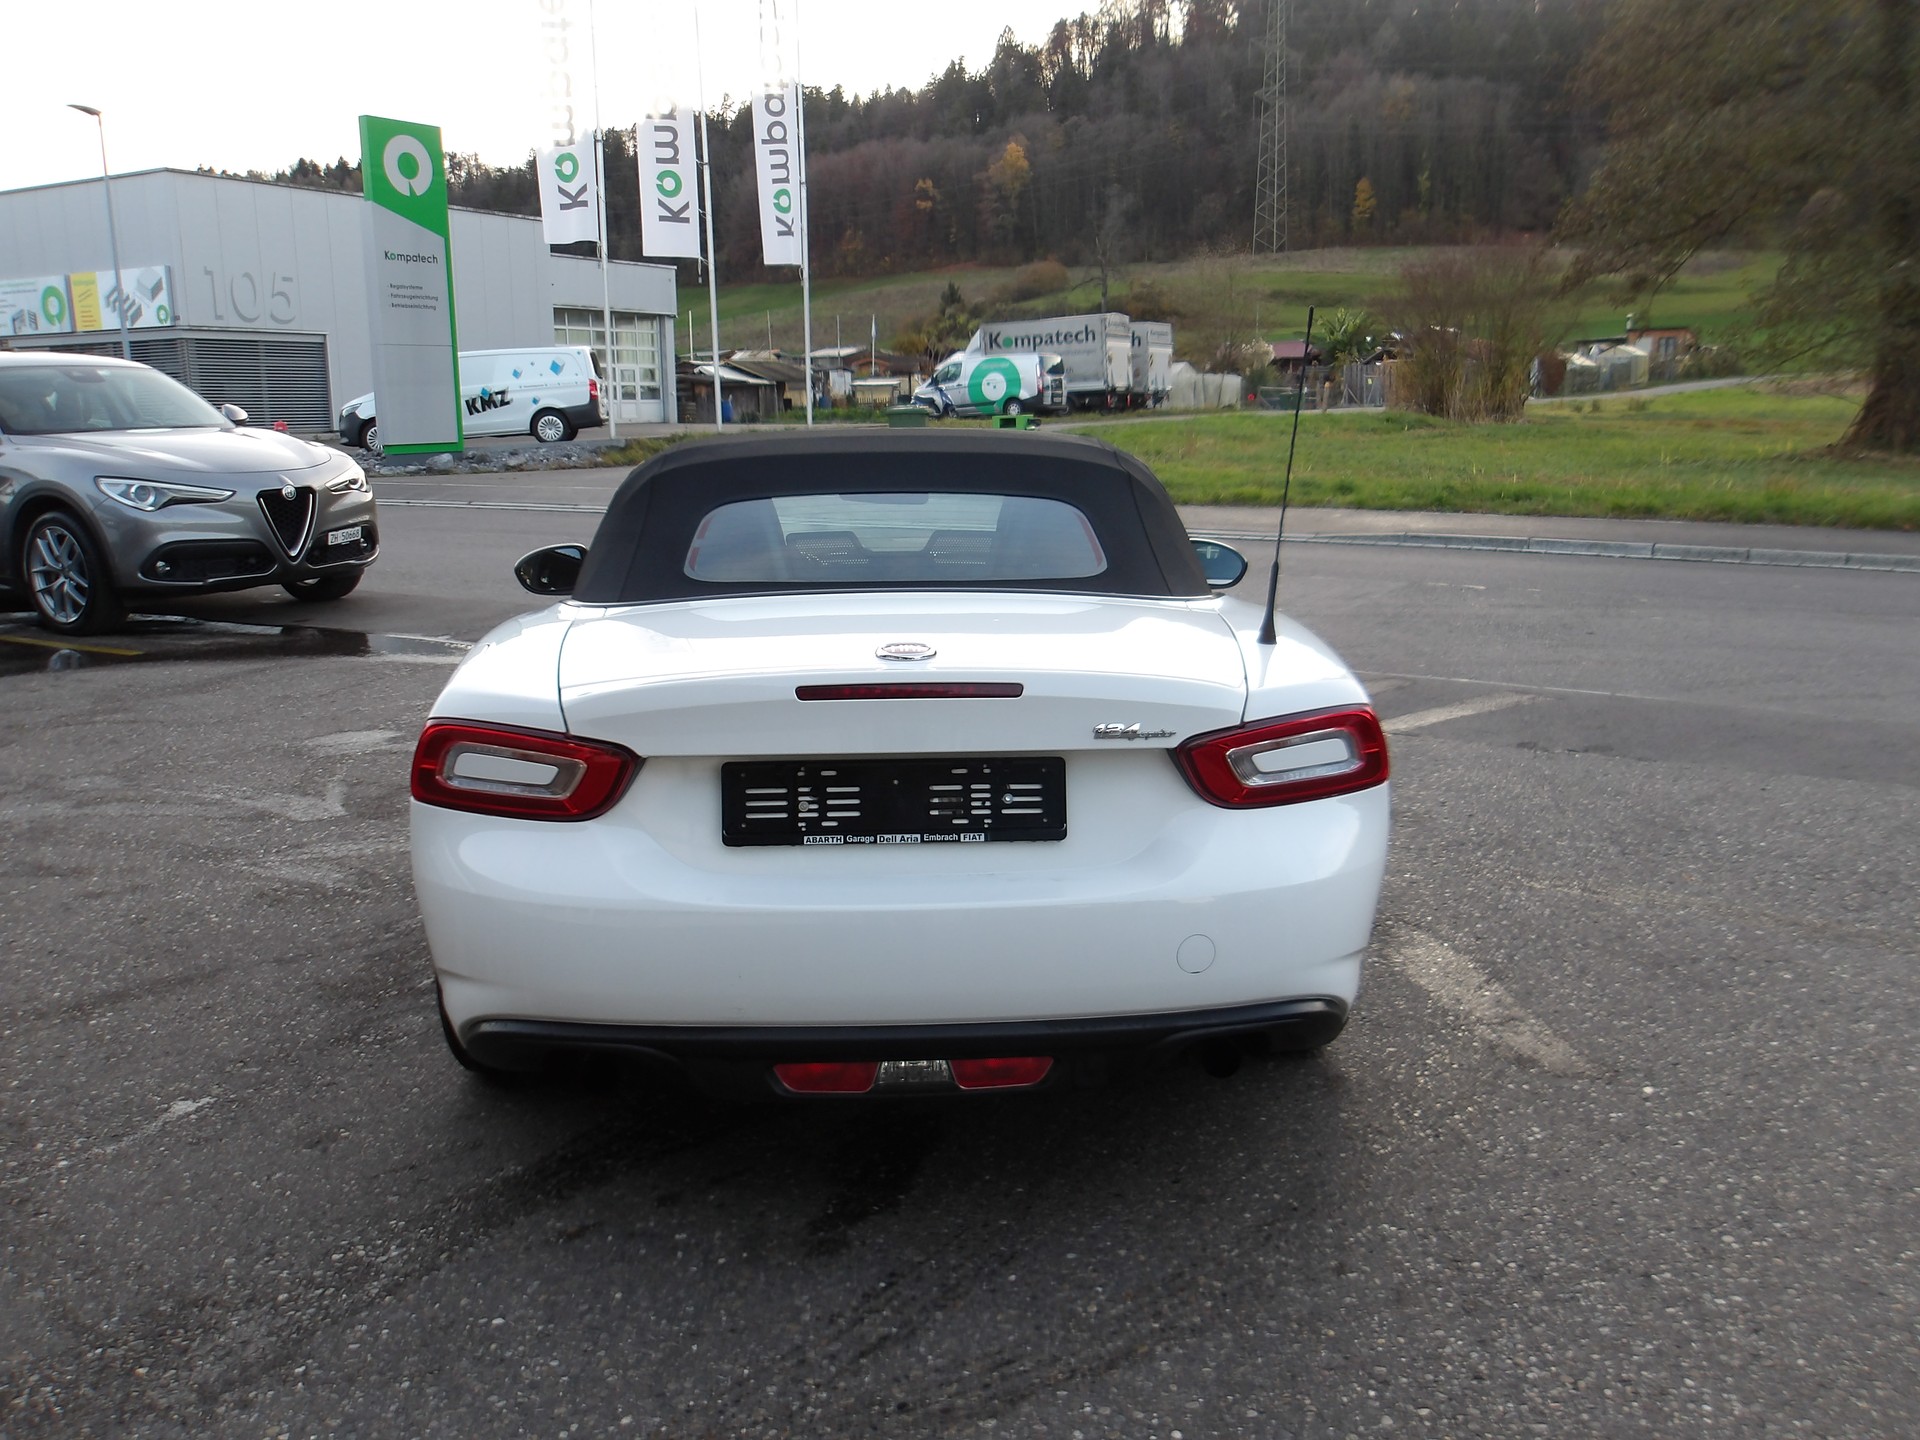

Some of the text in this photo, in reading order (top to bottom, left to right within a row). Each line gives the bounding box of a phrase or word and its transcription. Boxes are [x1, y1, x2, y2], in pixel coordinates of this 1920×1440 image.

[384, 250, 438, 264] Kompatech
[203, 265, 297, 325] 105
[988, 324, 1096, 352] Kompatech
[465, 387, 512, 416] KMZ
[330, 528, 360, 543] ZH 50668
[805, 833, 983, 844] ABARTH Garage Dell Aria Embrach FIAT
